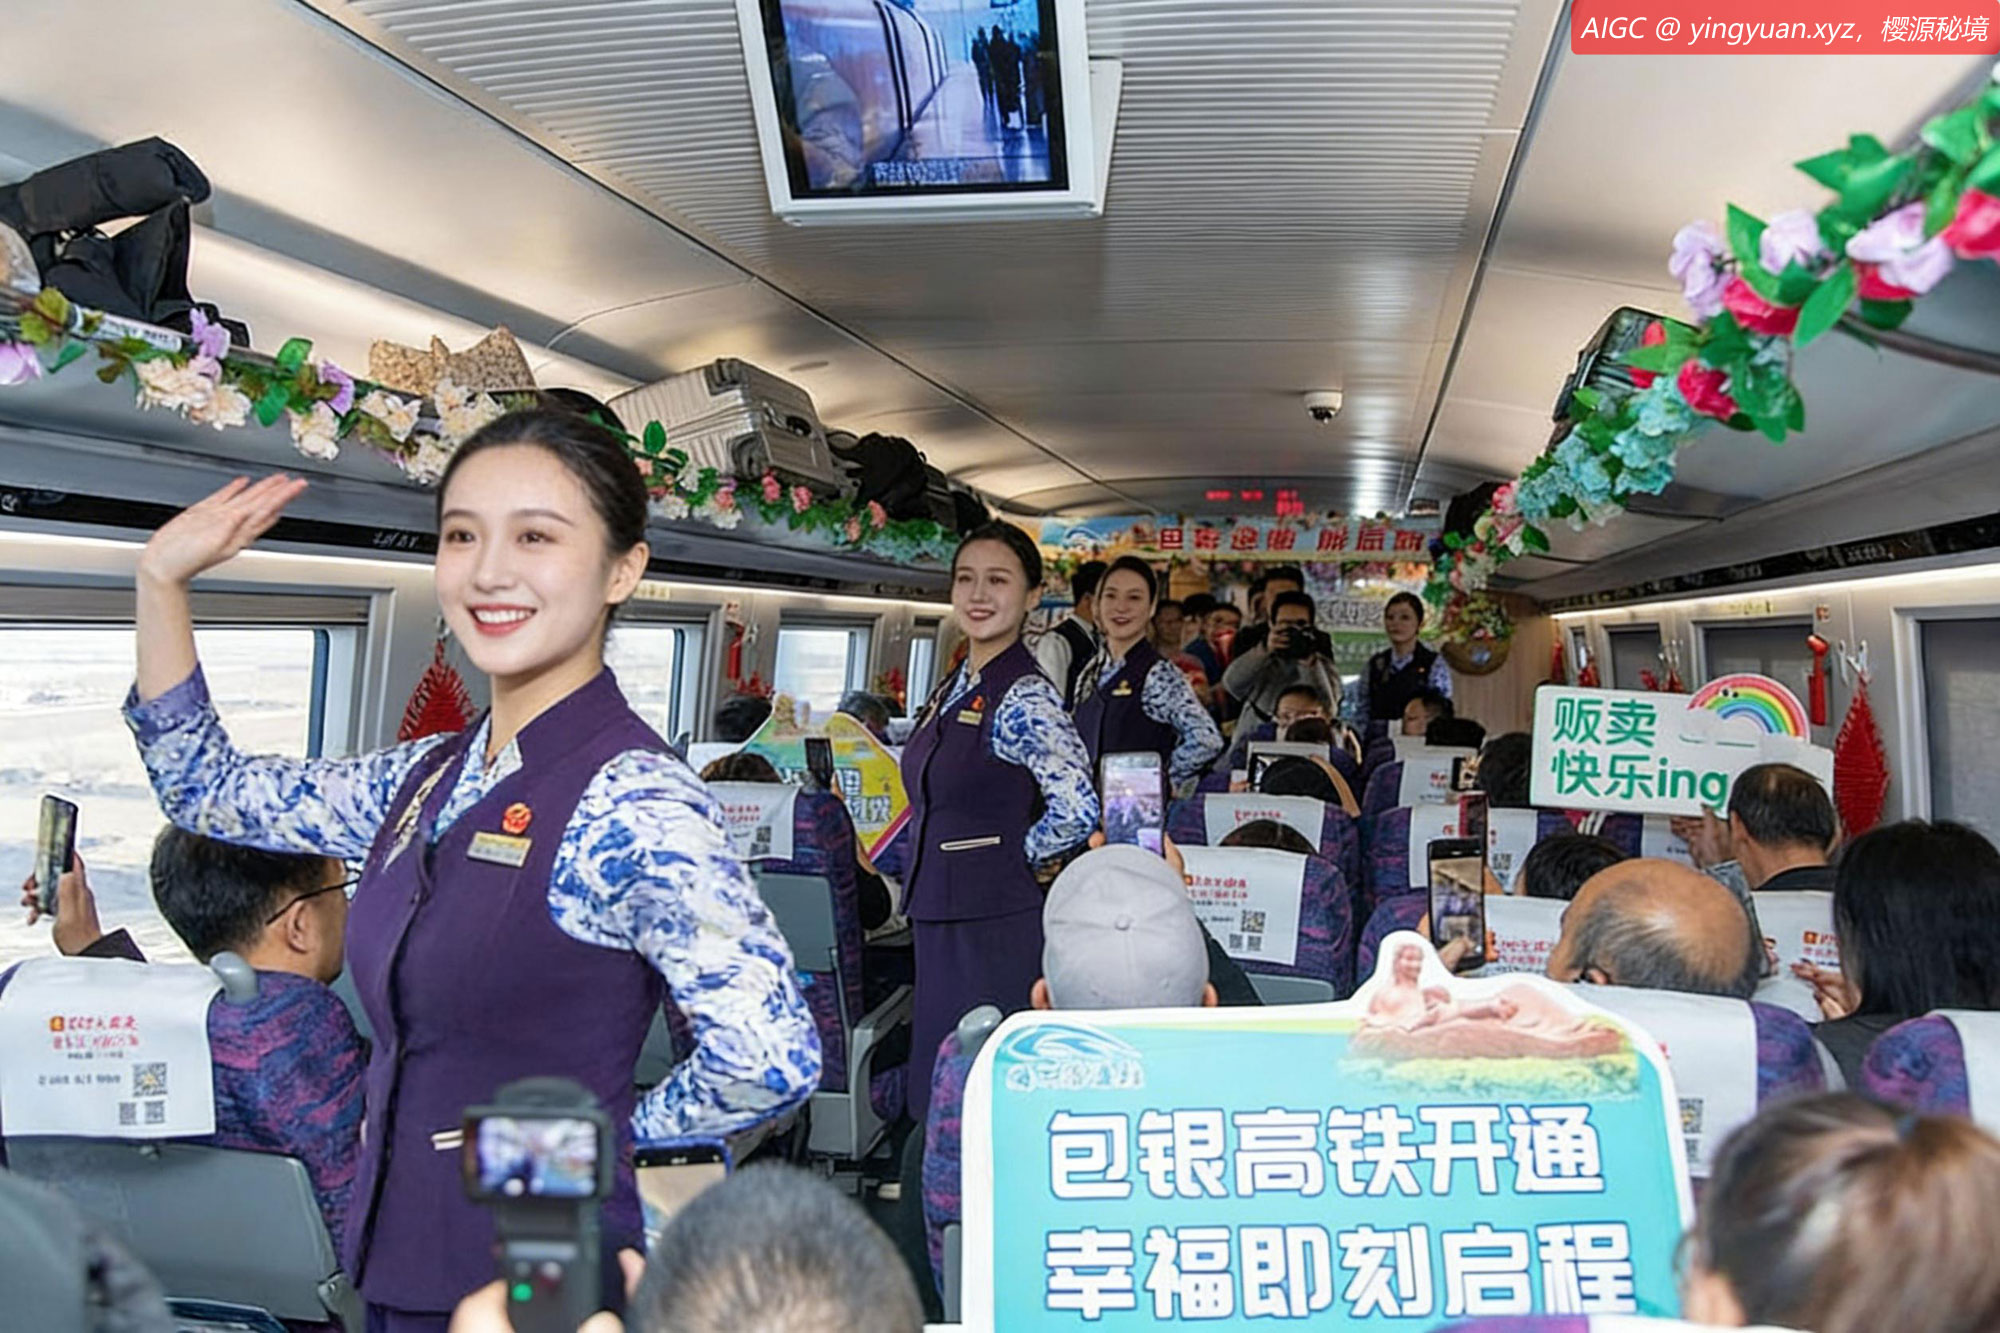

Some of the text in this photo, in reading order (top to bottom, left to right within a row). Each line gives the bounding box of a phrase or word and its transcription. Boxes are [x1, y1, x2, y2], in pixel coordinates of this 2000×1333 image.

[1553, 698, 1656, 748] 贩卖
[1551, 750, 1728, 809] 快乐ing
[1047, 1105, 1606, 1198] 包银高铁开通
[1045, 1222, 1638, 1320] 幸福即刻启程
